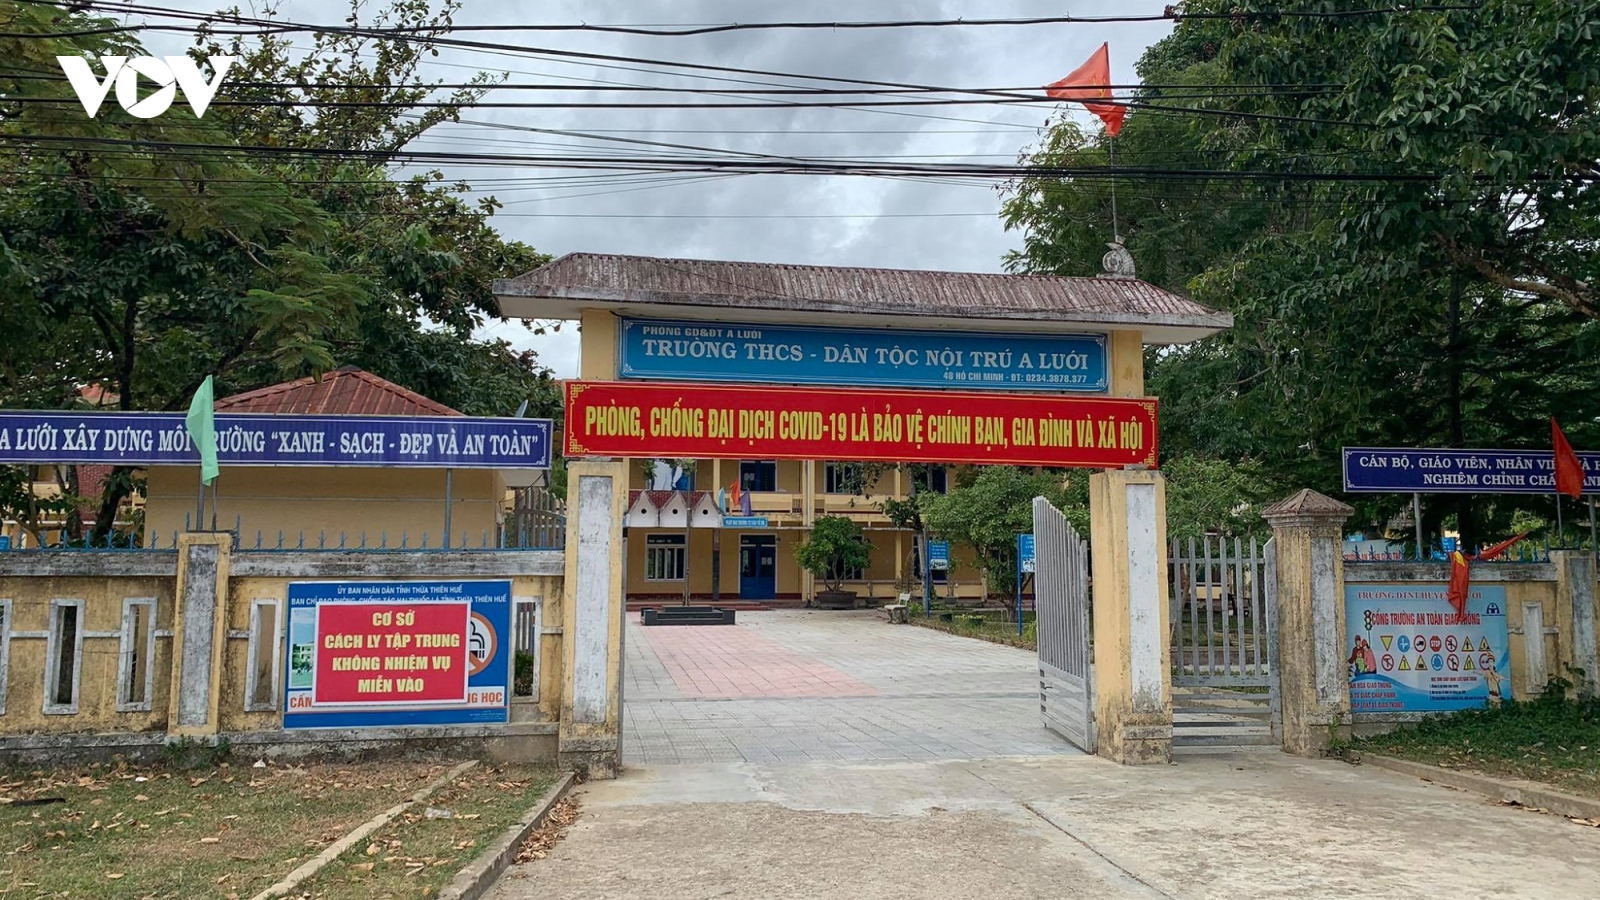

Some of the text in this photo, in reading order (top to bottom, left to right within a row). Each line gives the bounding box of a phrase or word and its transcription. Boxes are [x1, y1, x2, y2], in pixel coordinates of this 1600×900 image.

[726, 329, 734, 338] A
[743, 342, 803, 362] THCS
[824, 344, 868, 364] DÂN
[875, 345, 919, 369] TỘC
[925, 346, 963, 371] NỘI
[969, 348, 1012, 369] TRÚ
[1018, 352, 1034, 369] A
[1039, 350, 1088, 370] LƯỚI
[943, 371, 954, 380] 48
[983, 372, 1004, 382] MINH
[1011, 373, 1024, 382] ĐT:
[585, 397, 1142, 456] PHÒNG, CHỐNG ĐẠI DỊCH COVID-19 LÀ BẢO VỆ CHÍNH BẠN, GIA ĐÌNH VÀ XÃ HỘI
[16, 422, 58, 451] LƯỚI
[62, 422, 100, 451] XÂY
[104, 426, 153, 456] DỰNG
[158, 424, 192, 452] MÔI
[271, 431, 325, 454] “XANH
[340, 432, 385, 458] SẠCH
[400, 433, 432, 460] ĐẸP
[436, 428, 459, 455] VÀ
[462, 434, 485, 456] AN
[490, 429, 538, 456] TOÀN”
[1360, 454, 1388, 468] CÁN
[1392, 454, 1414, 470] BỘ,
[1418, 455, 1451, 469] GIÁO
[1455, 455, 1492, 471] VIÊN,
[1496, 456, 1533, 470] NHÂN
[1537, 456, 1556, 470] VIÊ
[1424, 471, 1556, 486] NGHIÊM CHỈNH CHẤ
[348, 586, 361, 594] BAN
[362, 586, 380, 594] NHÂN
[381, 586, 396, 594] DÂN
[430, 585, 448, 594] THIÊN
[449, 584, 463, 594] HUẾ
[291, 598, 305, 606] BAN
[474, 594, 493, 604] THIÊN
[494, 593, 508, 603] HUẾ
[372, 610, 416, 626] CƠ SỞ
[1416, 612, 1426, 626] AN
[1427, 610, 1444, 626] TOÀN
[324, 632, 460, 651] CÁCH LY TẬP TRUNG
[332, 654, 451, 673] KHÔNG NHIỆM VỤ
[358, 676, 424, 694] MIỄN VÀO
[481, 692, 502, 706] HỌC
